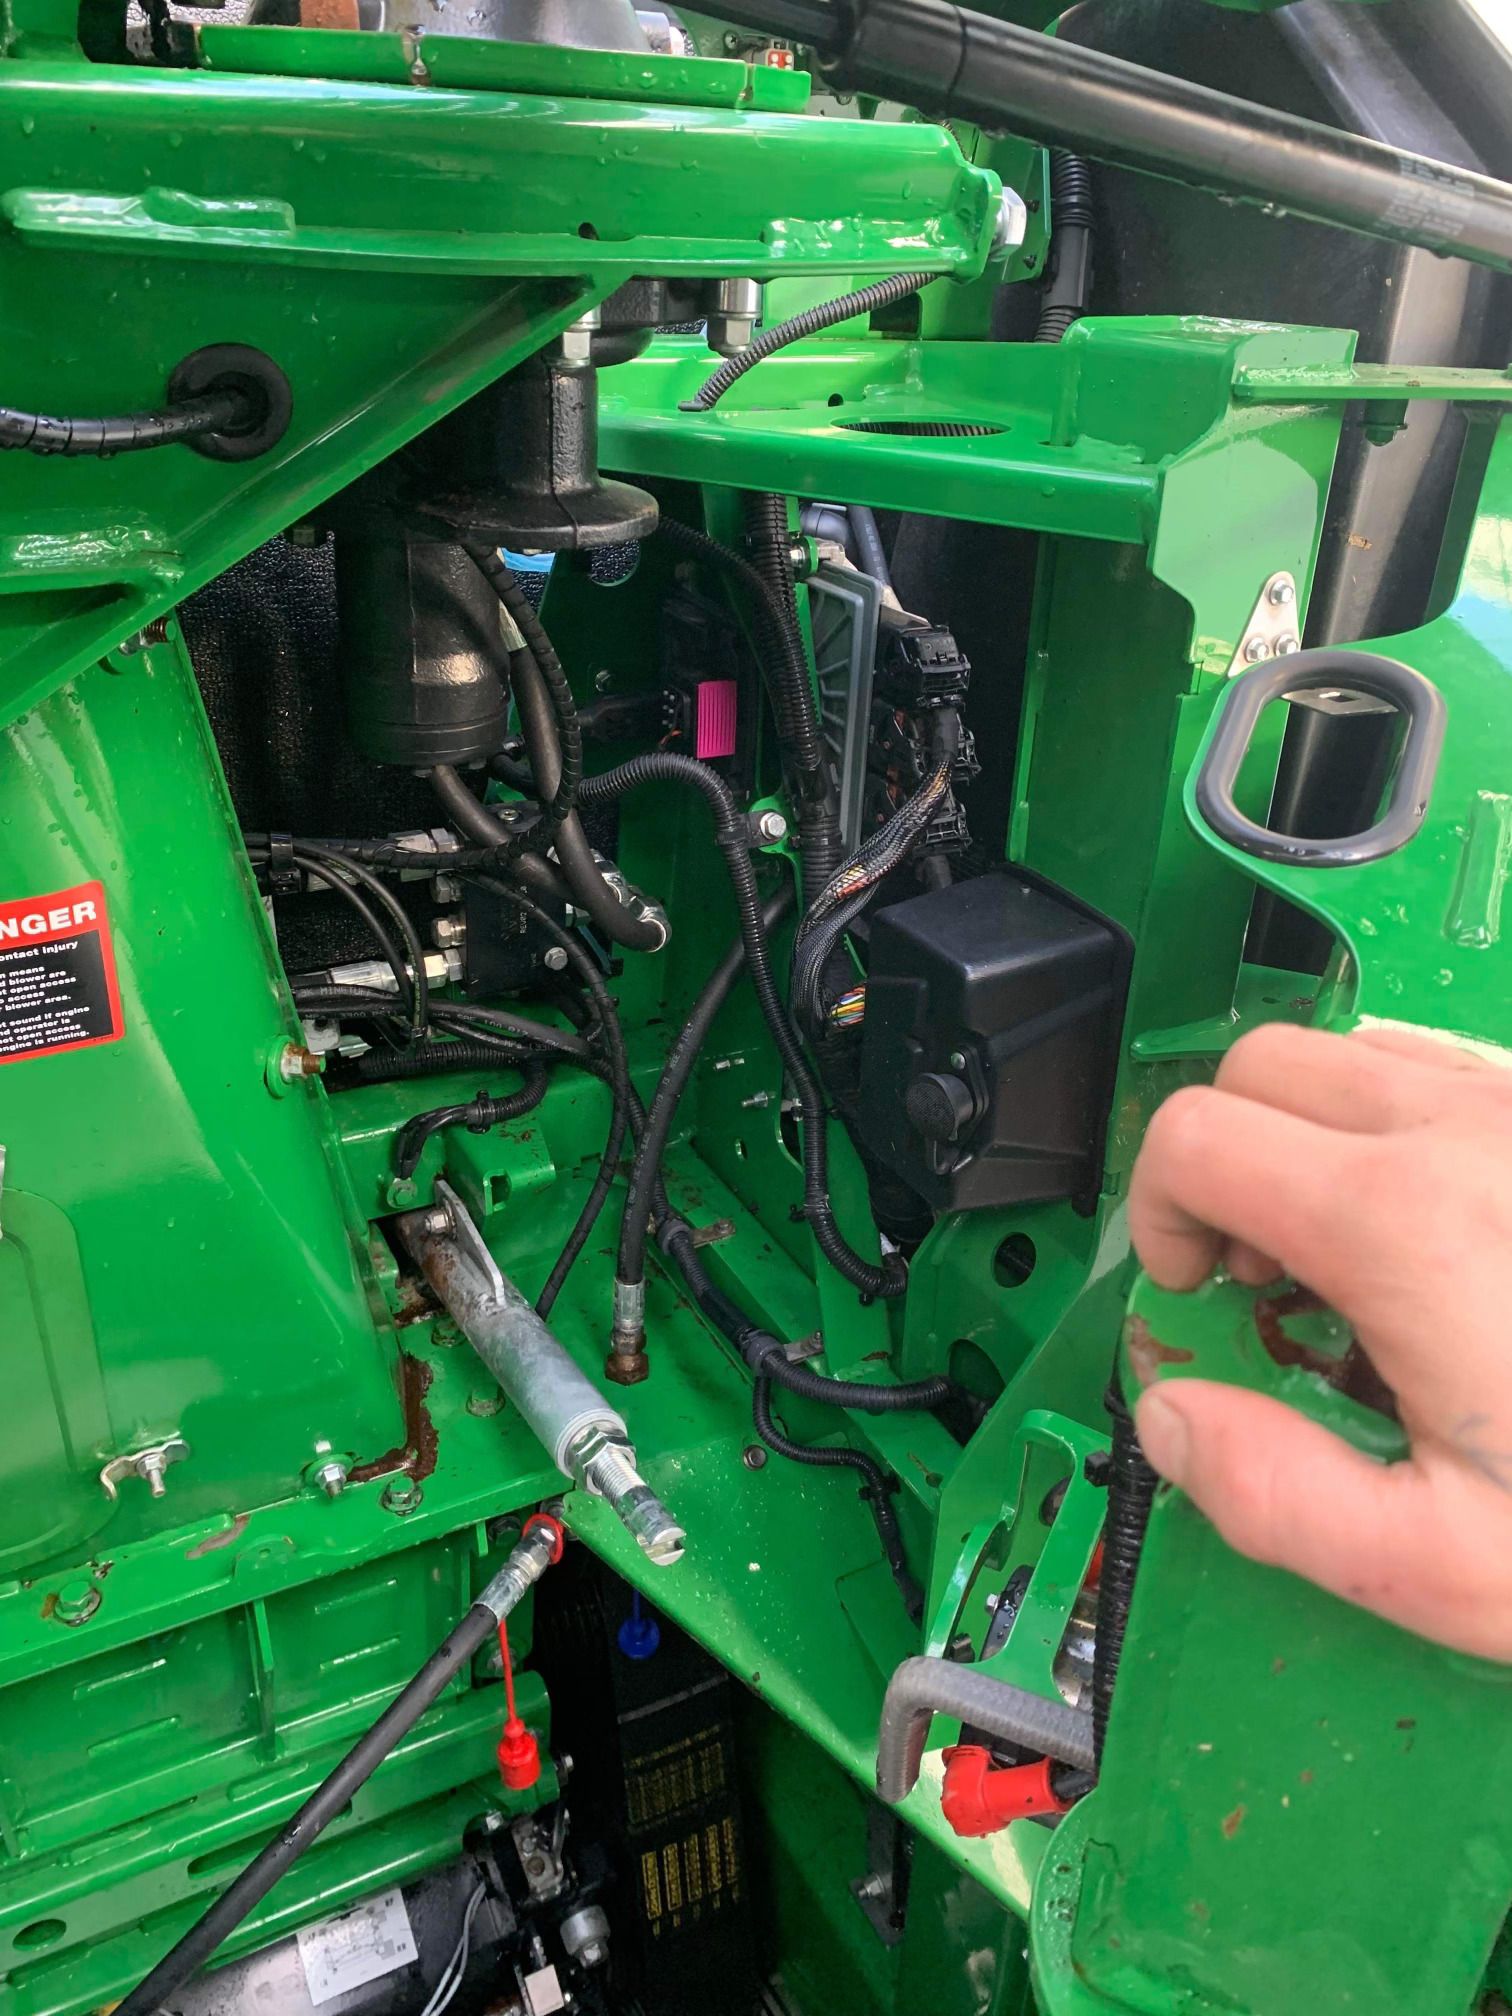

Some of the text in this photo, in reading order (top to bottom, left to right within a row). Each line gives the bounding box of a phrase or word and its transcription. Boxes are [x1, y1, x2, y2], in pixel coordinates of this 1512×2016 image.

[9, 966, 45, 977] means
[9, 974, 46, 986] blower
[10, 984, 36, 994] open
[40, 977, 76, 988] access
[5, 999, 41, 1011] blower
[45, 995, 71, 1003] area.
[8, 991, 45, 1002] access
[9, 1015, 41, 1026] sound
[55, 1006, 90, 1017] engine
[14, 1020, 58, 1033] operator
[17, 1031, 42, 1041] open
[45, 1024, 81, 1035] access
[47, 1030, 90, 1042] running.
